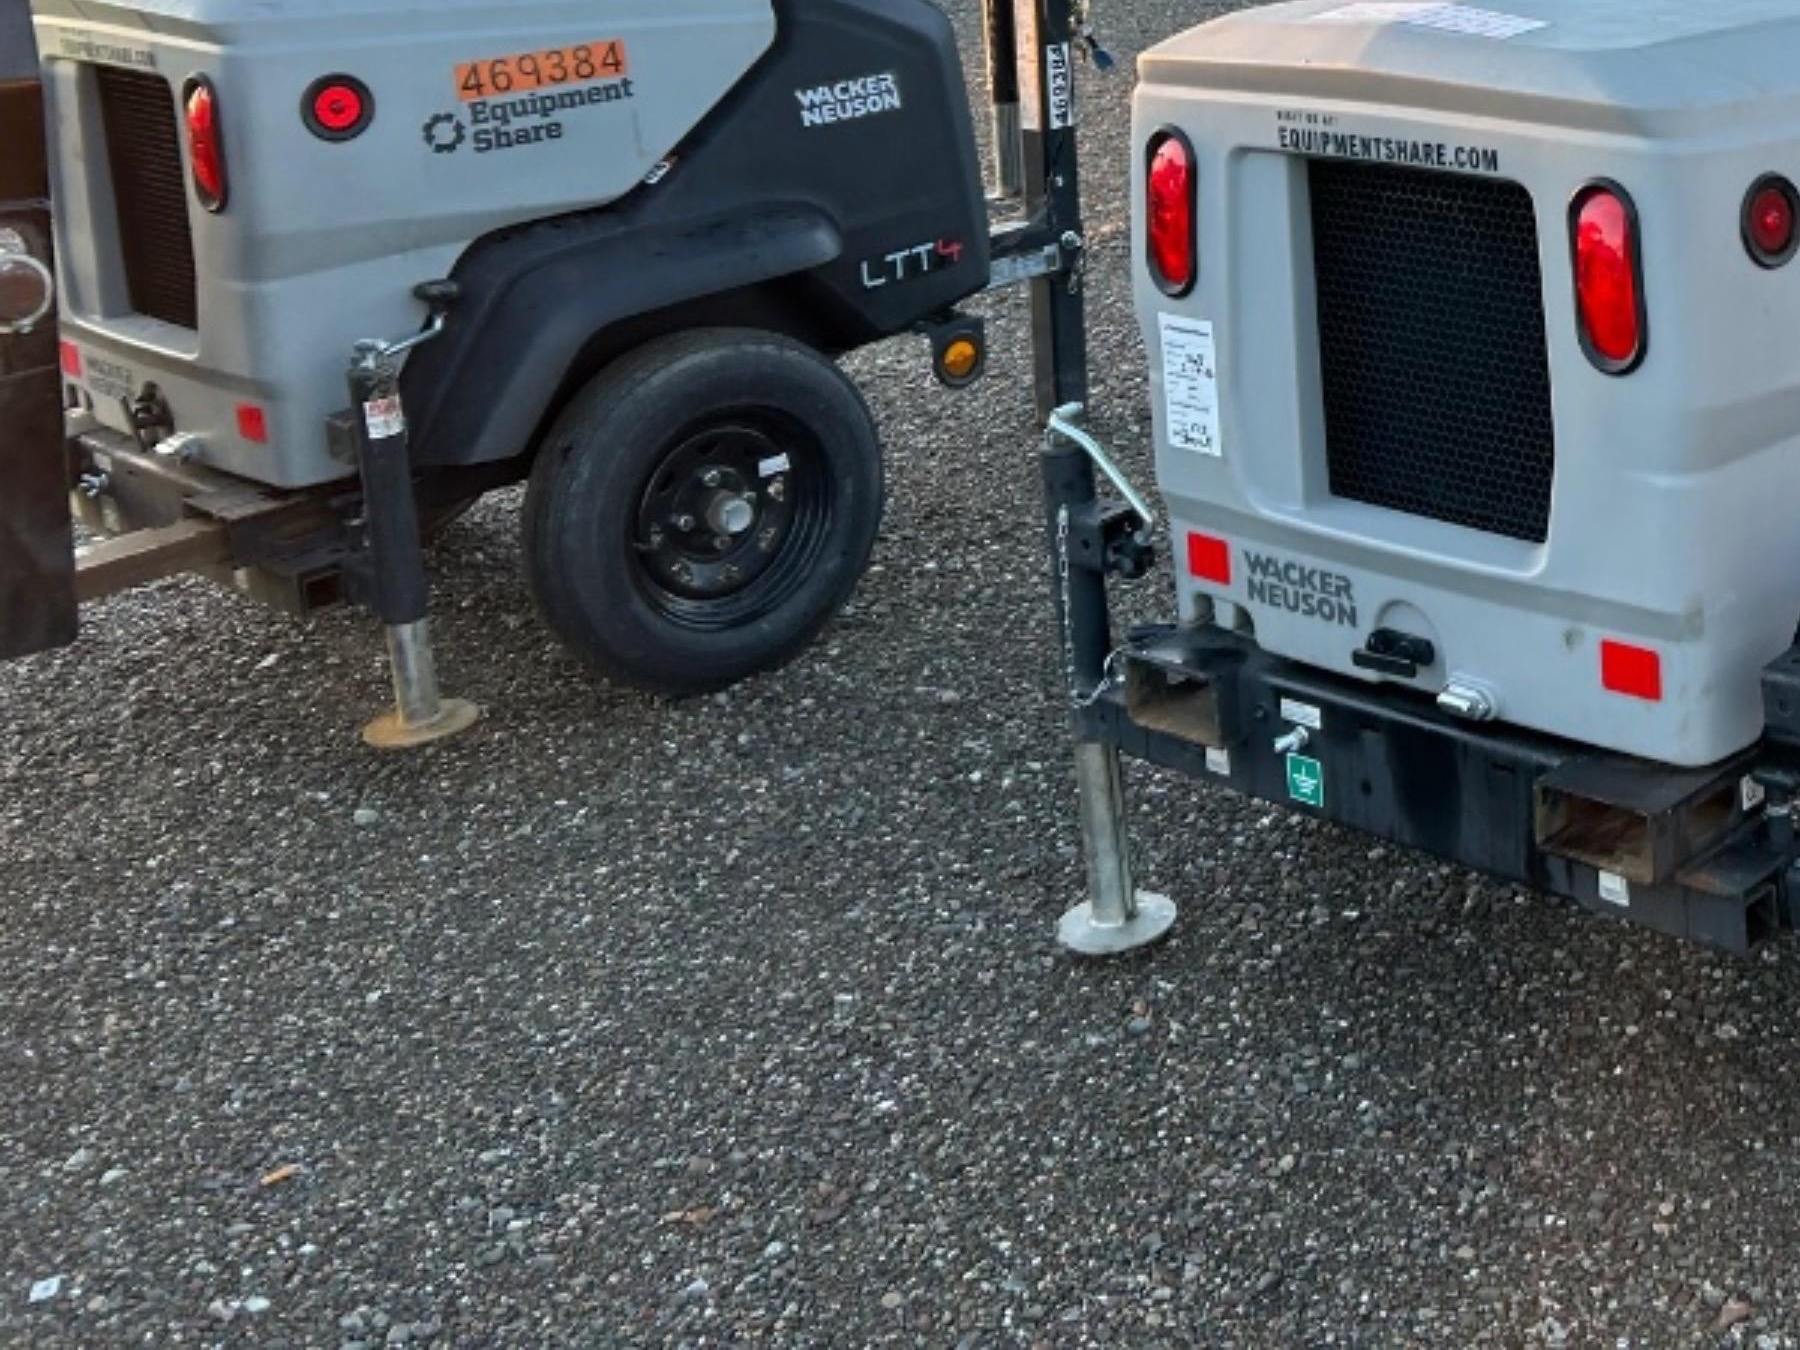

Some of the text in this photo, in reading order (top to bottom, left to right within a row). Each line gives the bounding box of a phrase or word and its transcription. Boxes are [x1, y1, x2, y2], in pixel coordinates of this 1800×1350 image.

[460, 41, 622, 96] 469384
[795, 72, 896, 107] WACKER
[468, 76, 634, 126] Equipment
[801, 88, 901, 127] NEUSON
[472, 121, 563, 154] Share
[1278, 125, 1499, 172] EQUIPMENTSHARE.COM
[1243, 550, 1355, 602] WACKER
[1247, 576, 1358, 628] NEUSON
